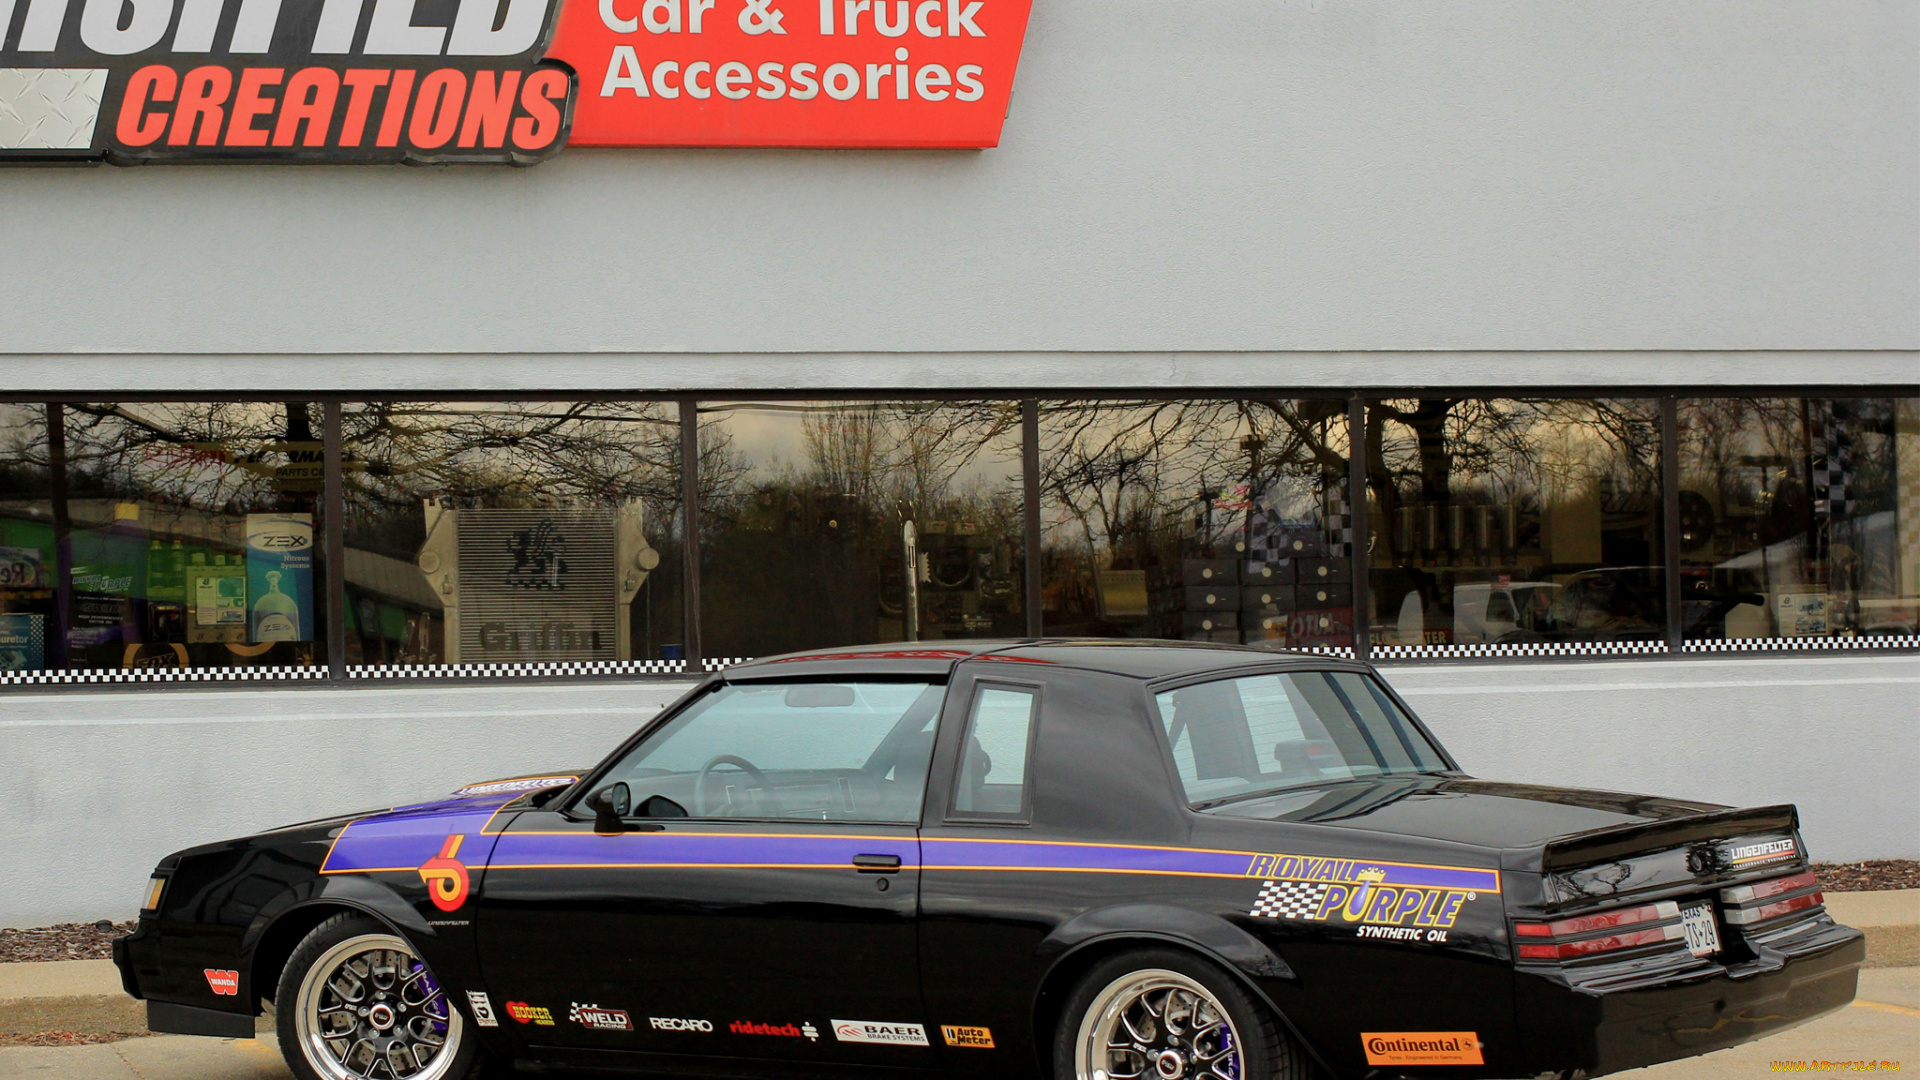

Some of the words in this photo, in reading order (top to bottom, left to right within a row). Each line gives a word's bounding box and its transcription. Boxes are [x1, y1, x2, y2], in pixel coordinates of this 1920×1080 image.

[599, 0, 715, 34] Car
[737, 0, 788, 36] &
[599, 45, 986, 102] Accessories
[115, 64, 568, 151] CREATIONS
[275, 467, 308, 477] PARTS
[263, 535, 304, 547] ZEX
[283, 554, 310, 562] Nitrous
[280, 562, 310, 571] Systems
[1731, 839, 1794, 860] LINGENFELTER
[1245, 852, 1358, 882] ROYAL
[1314, 884, 1468, 928] PURPLE
[1356, 925, 1424, 942] SYNTHETIC
[1426, 928, 1448, 943] OIL
[512, 1005, 553, 1020] HOOKER
[582, 1012, 628, 1024] WELD
[649, 1017, 713, 1032] RECARO
[729, 1020, 801, 1037] ridetech
[864, 1025, 921, 1036] BAER
[957, 1027, 983, 1037] Auto
[867, 1033, 893, 1041] BRAKE
[893, 1034, 926, 1042] SYSTEMS
[957, 1035, 991, 1045] Meter
[1368, 1037, 1461, 1056] Continental
